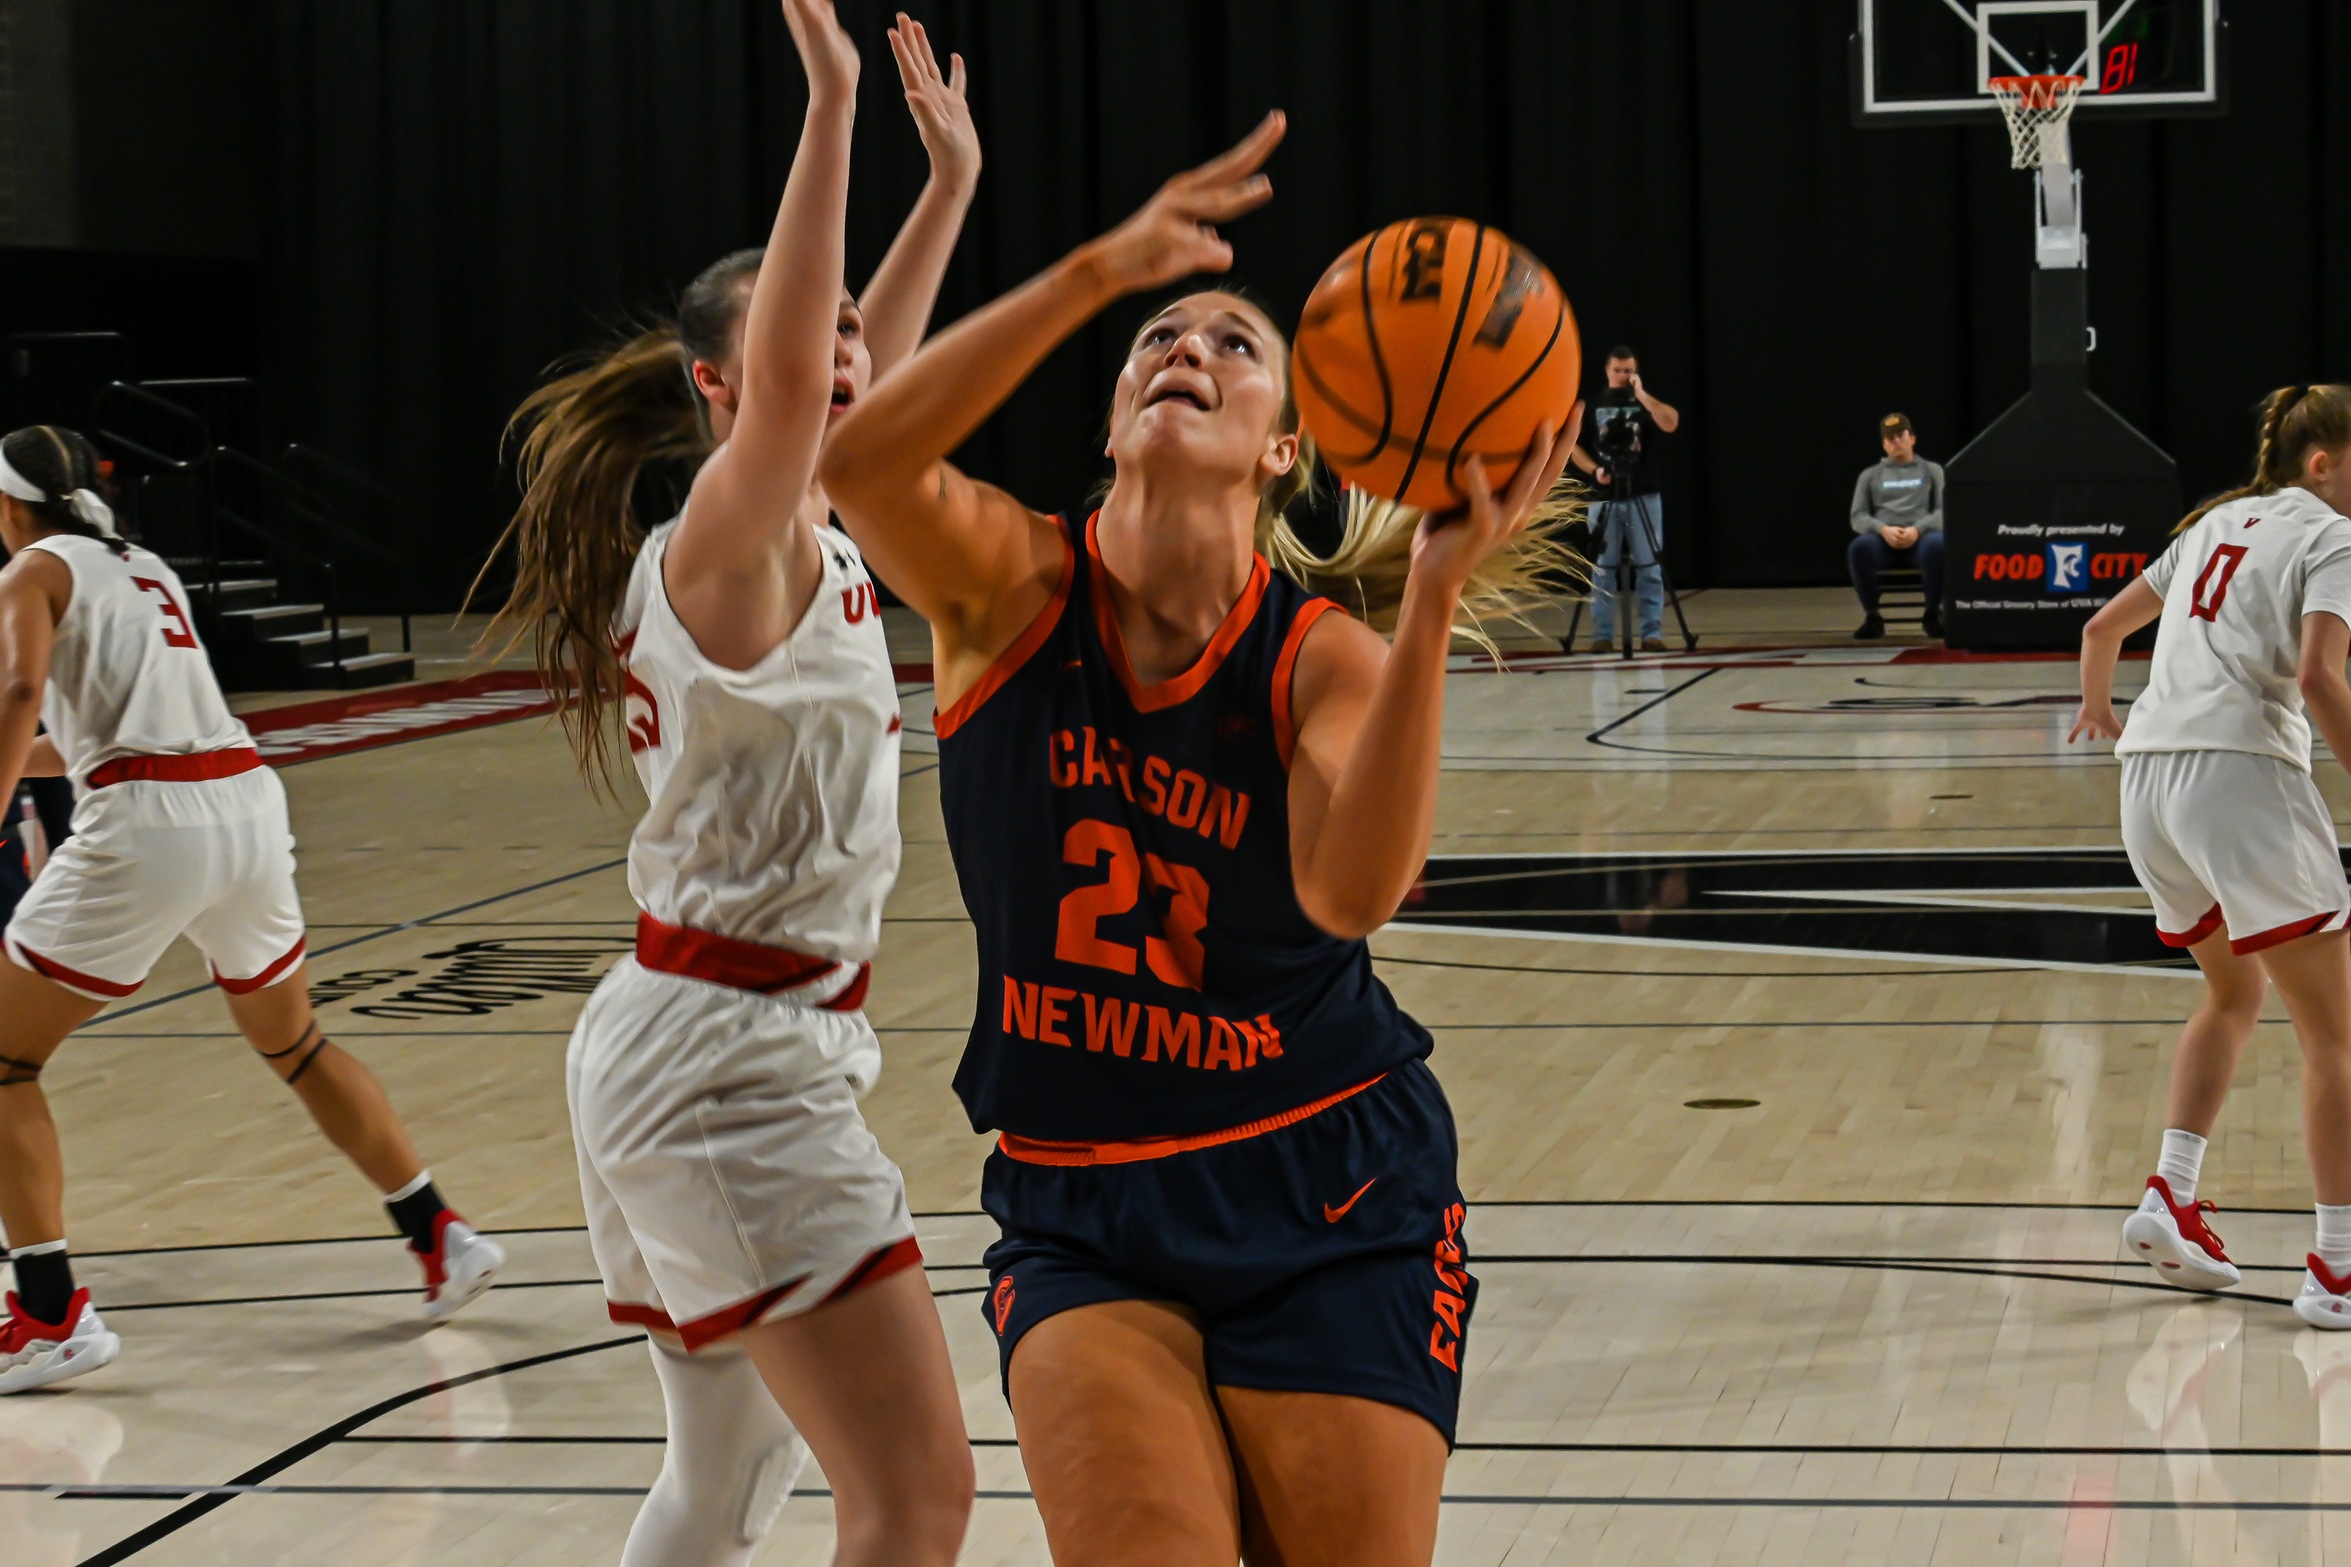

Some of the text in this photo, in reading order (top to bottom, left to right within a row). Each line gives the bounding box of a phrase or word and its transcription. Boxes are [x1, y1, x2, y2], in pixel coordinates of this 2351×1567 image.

[1974, 553, 2044, 580] FOOD
[2091, 552, 2148, 579] CITY
[1997, 523, 2125, 537] Proudly presented by
[129, 575, 199, 649] 3
[1955, 600, 1970, 609] The
[2189, 543, 2250, 622] 0
[1050, 726, 1250, 850] CARSON
[1055, 818, 1210, 993] 23
[1002, 974, 1284, 1072] NEWMAN
